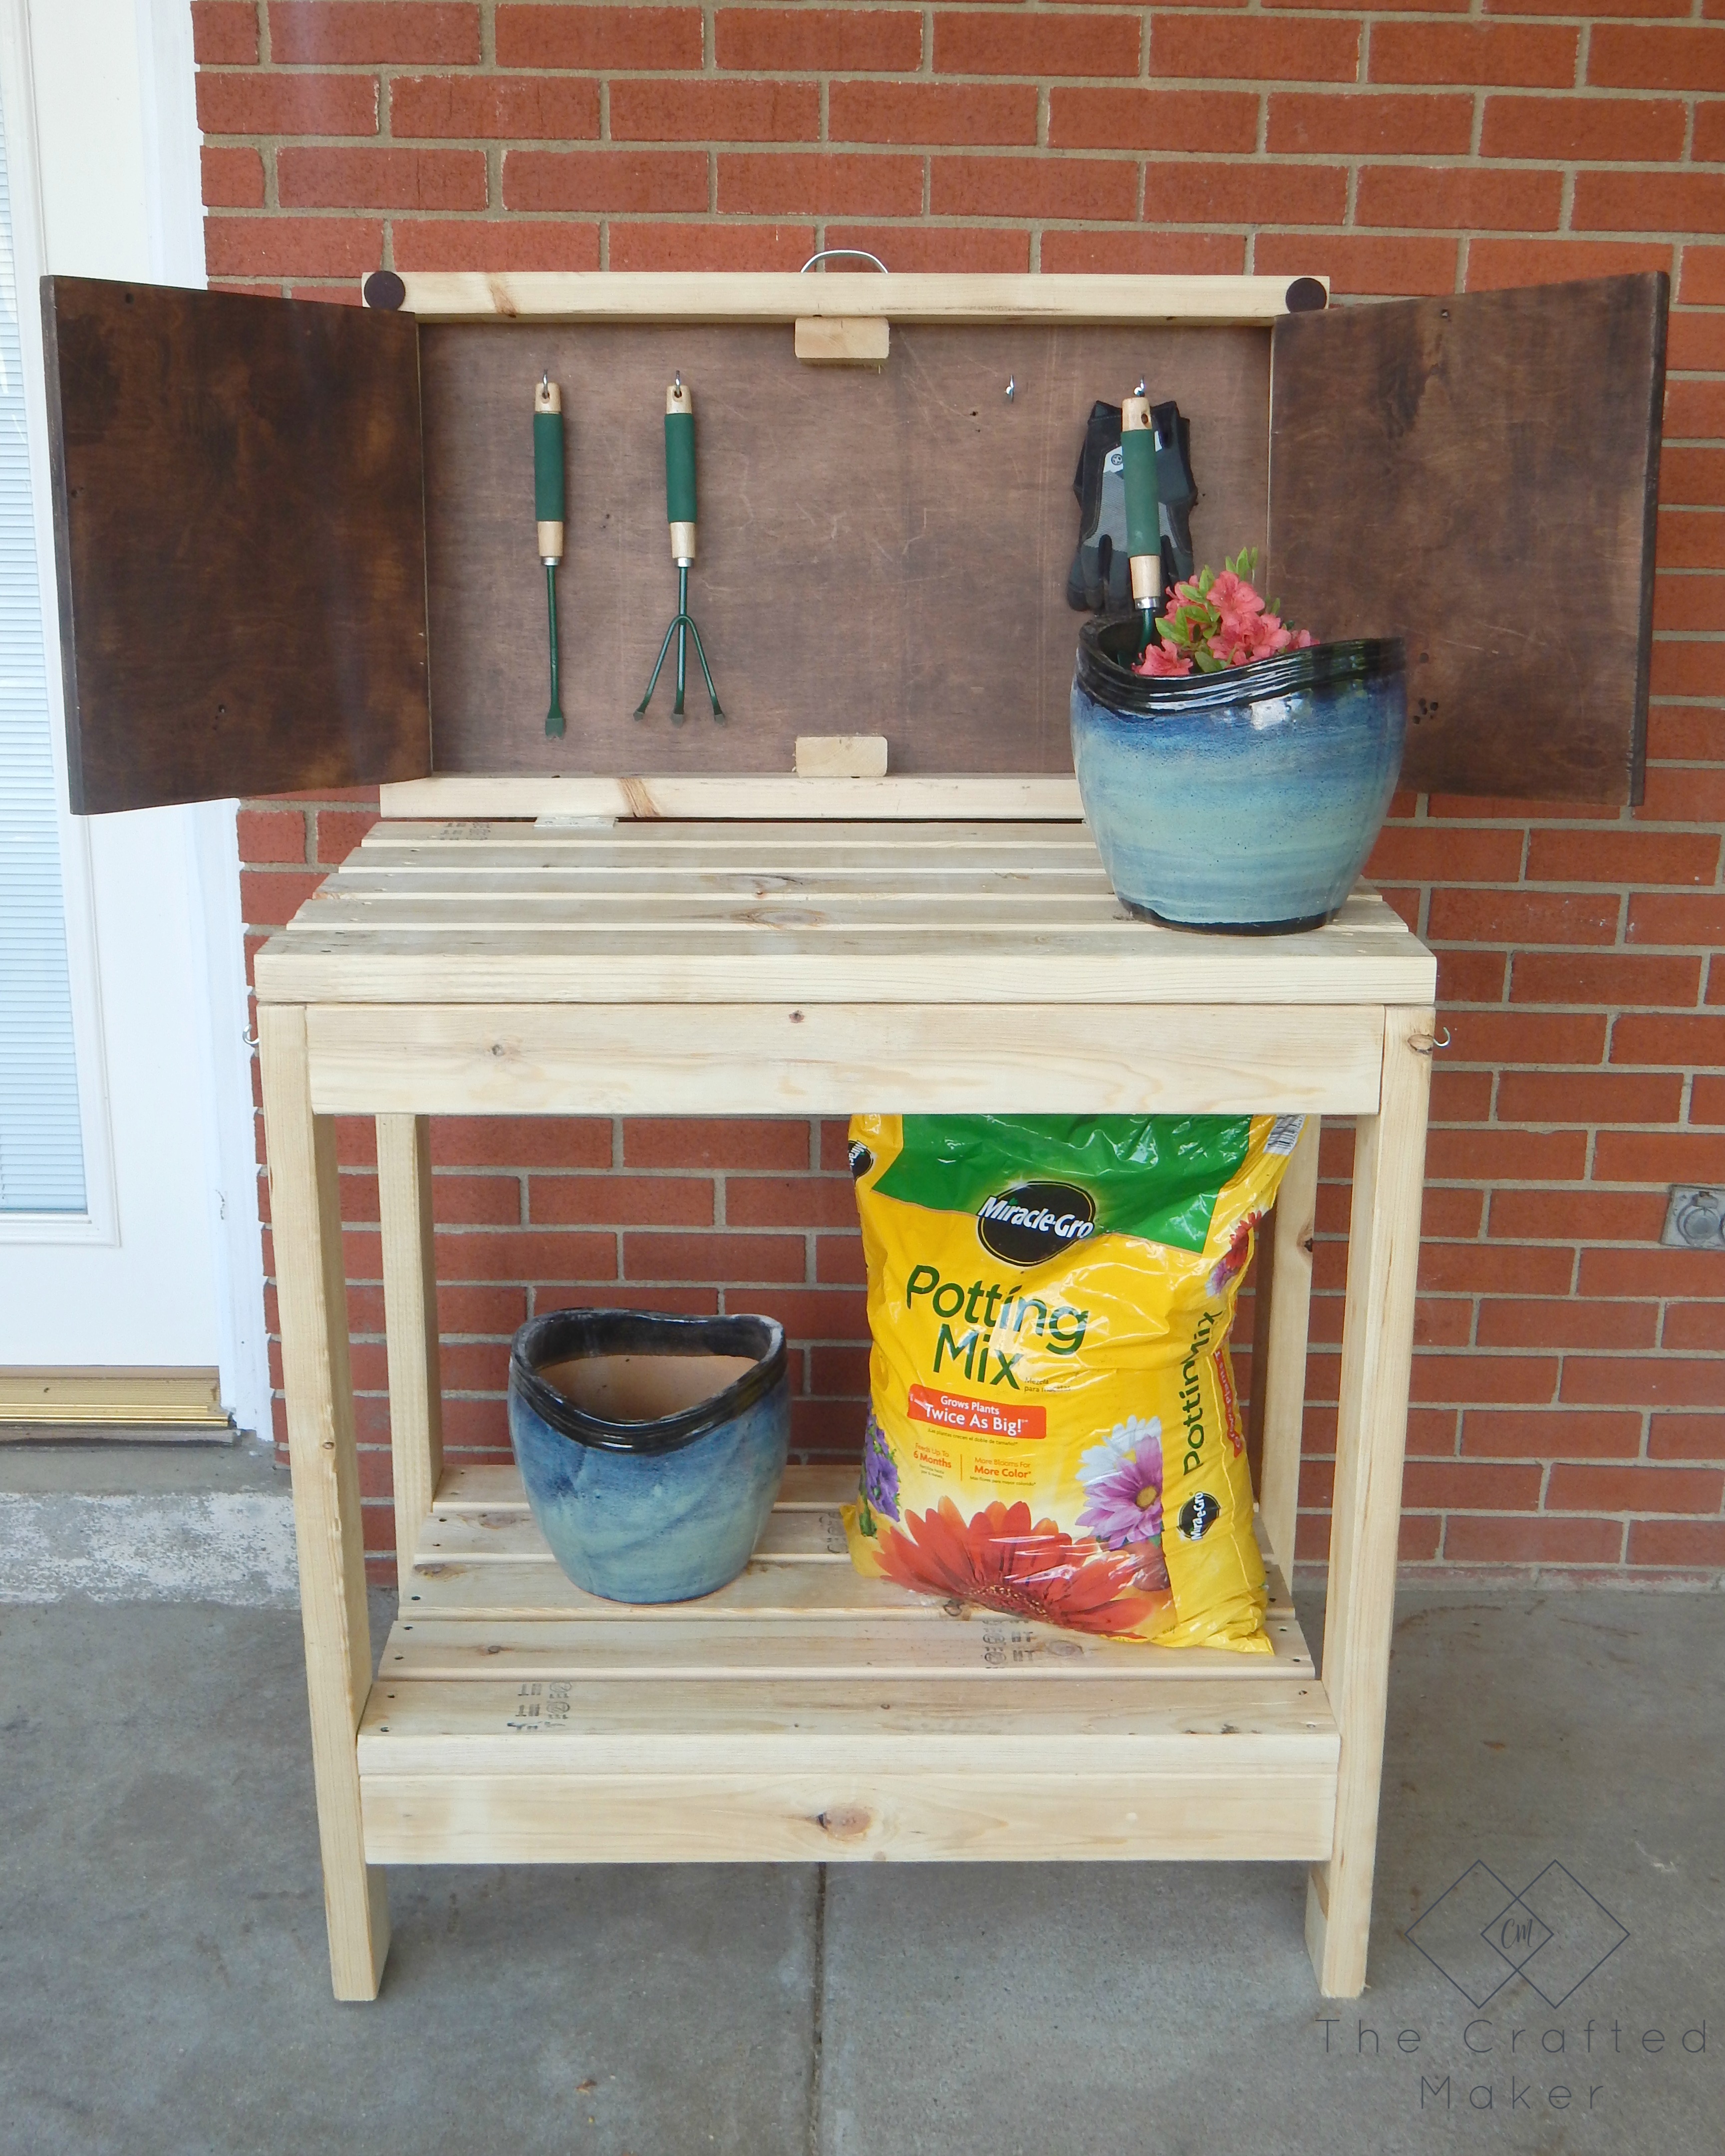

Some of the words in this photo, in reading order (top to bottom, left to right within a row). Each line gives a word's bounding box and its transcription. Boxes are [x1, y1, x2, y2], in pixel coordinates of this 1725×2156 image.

[977, 1196, 1094, 1239] Miracle-Gro
[907, 1265, 1089, 1355] Potting
[933, 1323, 1024, 1390] Mix
[924, 1403, 965, 1425] Twice
[969, 1413, 988, 1429] As
[940, 1395, 969, 1410] Grows
[971, 1401, 999, 1415] Plants
[1179, 1360, 1204, 1476] Pottin
[913, 1450, 918, 1459] 6
[920, 1452, 951, 1468] Months
[974, 1465, 999, 1476] More
[993, 1459, 1019, 1467] Blooms
